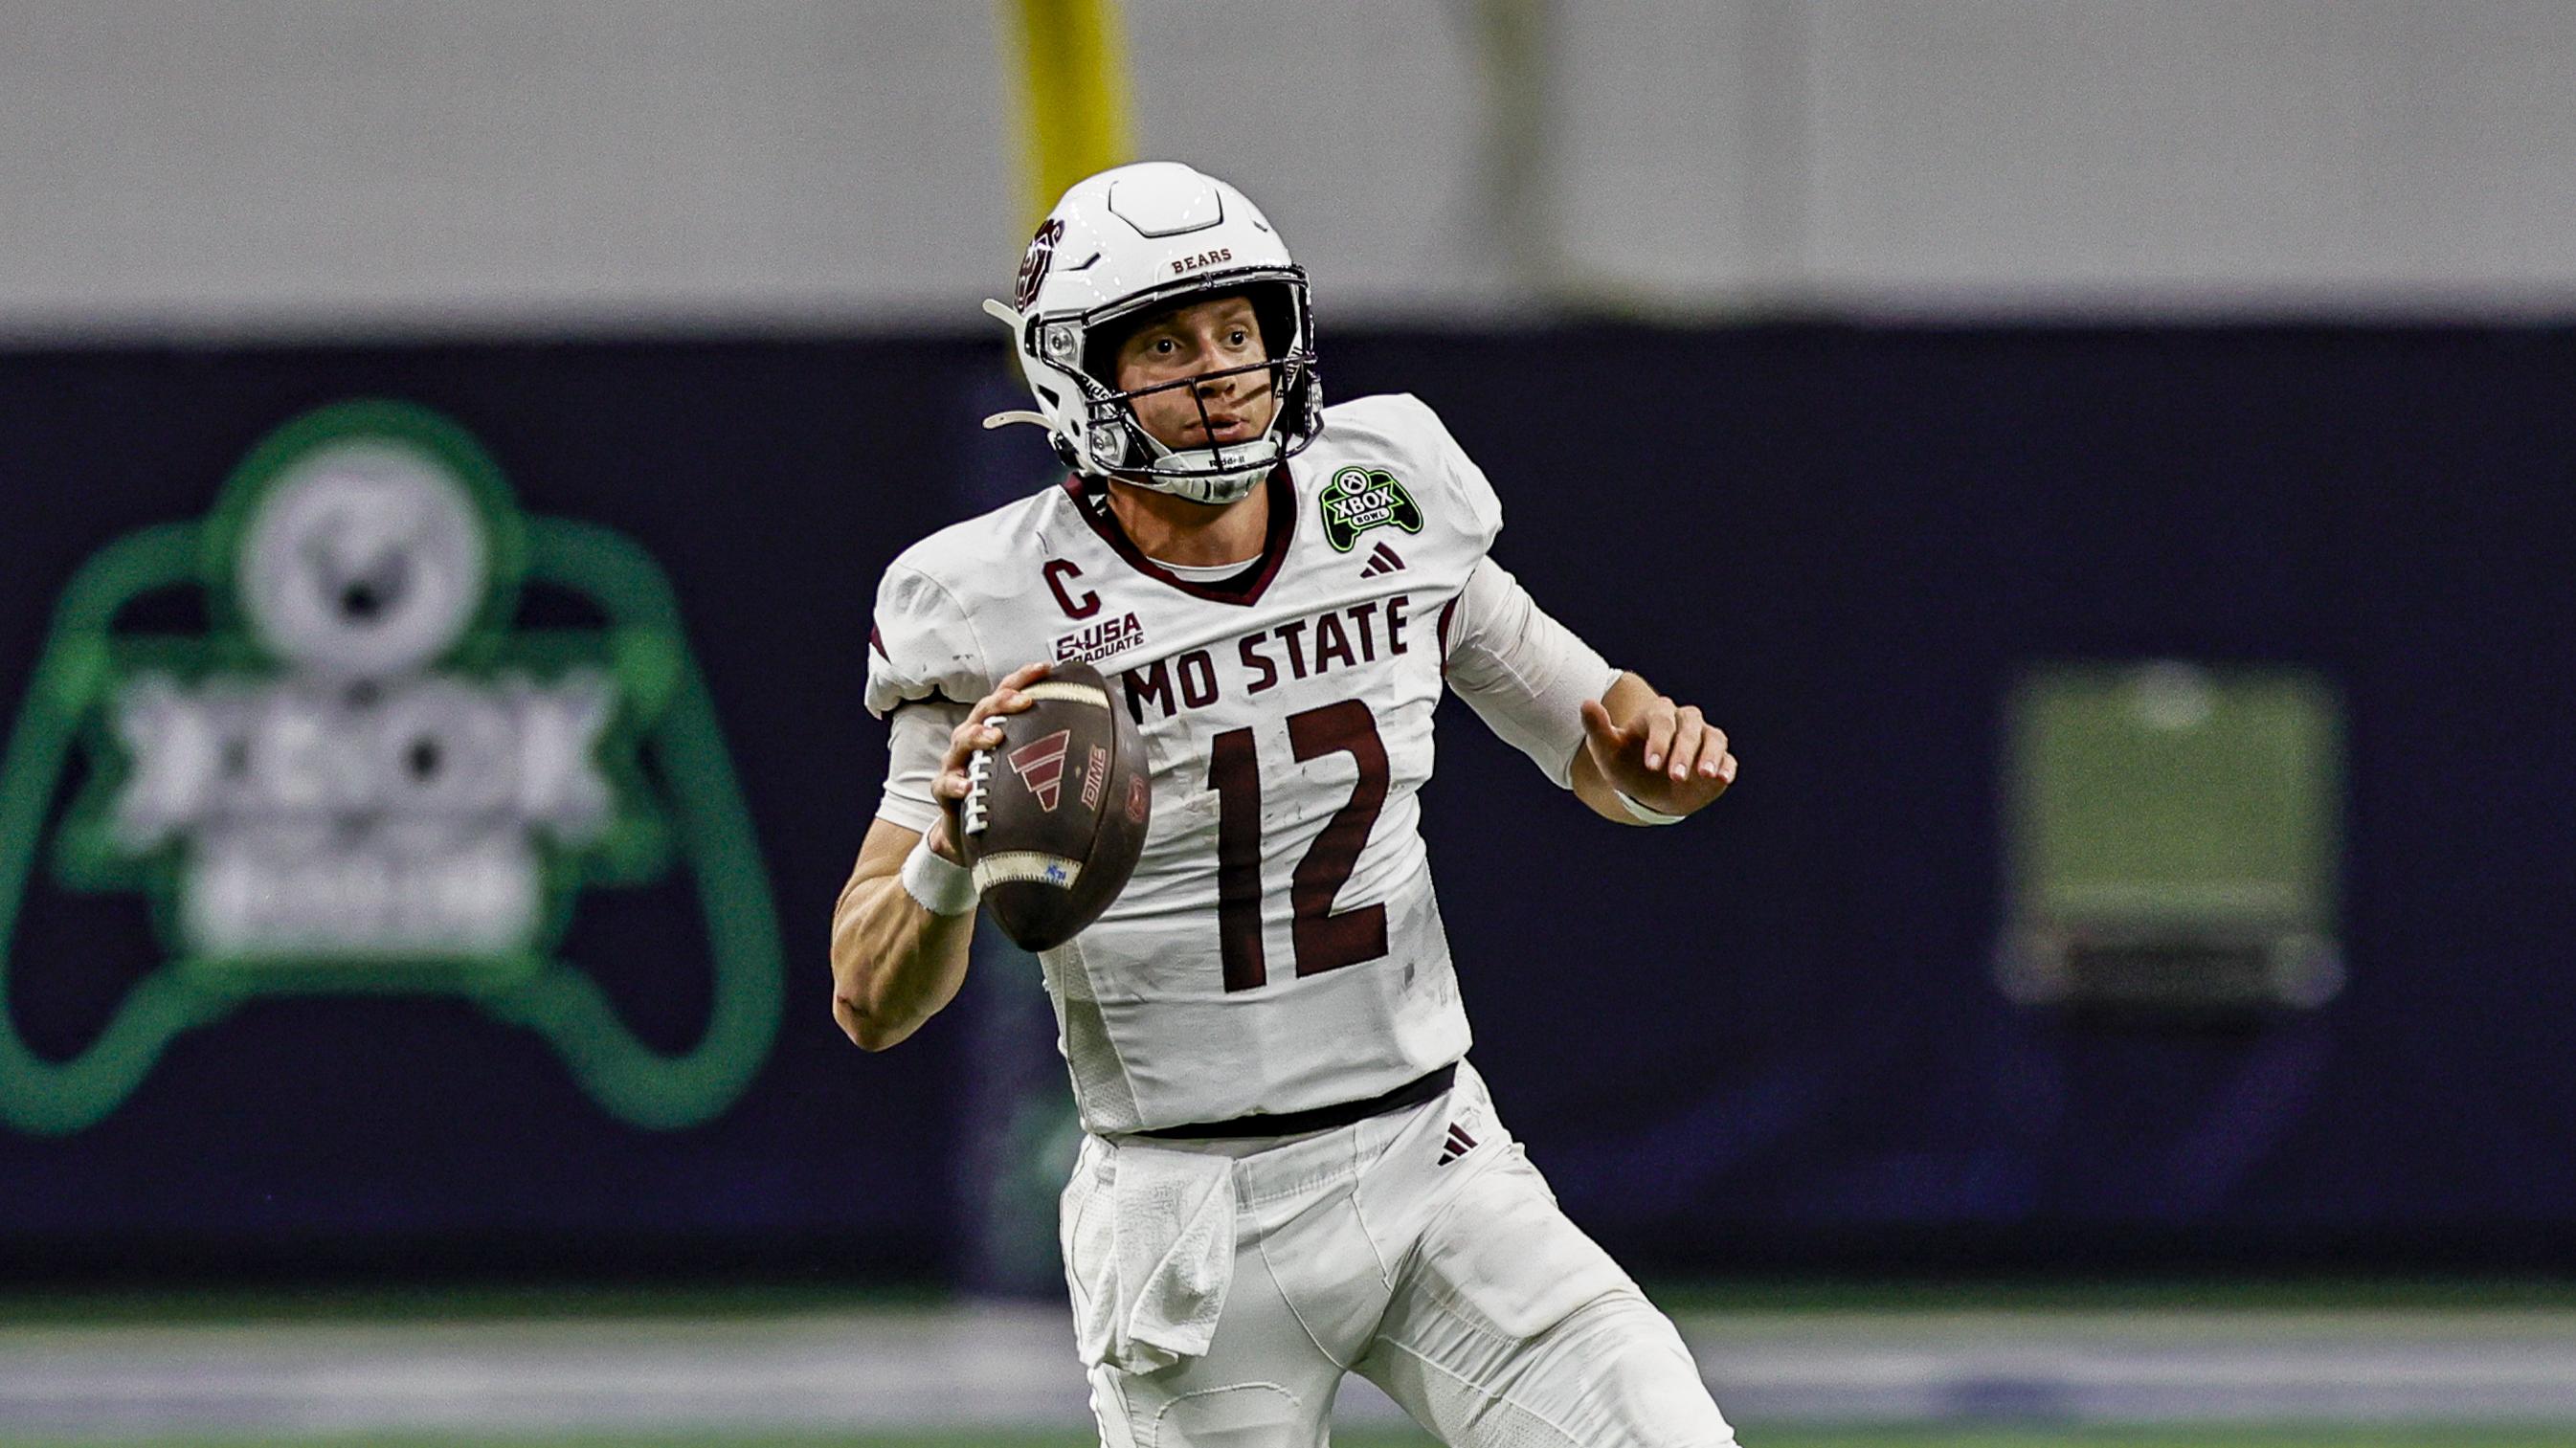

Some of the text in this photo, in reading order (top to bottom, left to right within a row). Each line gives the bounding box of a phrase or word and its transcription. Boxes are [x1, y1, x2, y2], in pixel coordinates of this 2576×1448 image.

[1171, 248, 1232, 274] BEARS
[1333, 486, 1395, 519] XBOX
[1355, 510, 1386, 524] BOWL
[1042, 558, 1101, 619] C
[1123, 595, 1410, 725] MO STATE
[1082, 745, 1107, 811] DIME
[1207, 698, 1391, 993] 12
